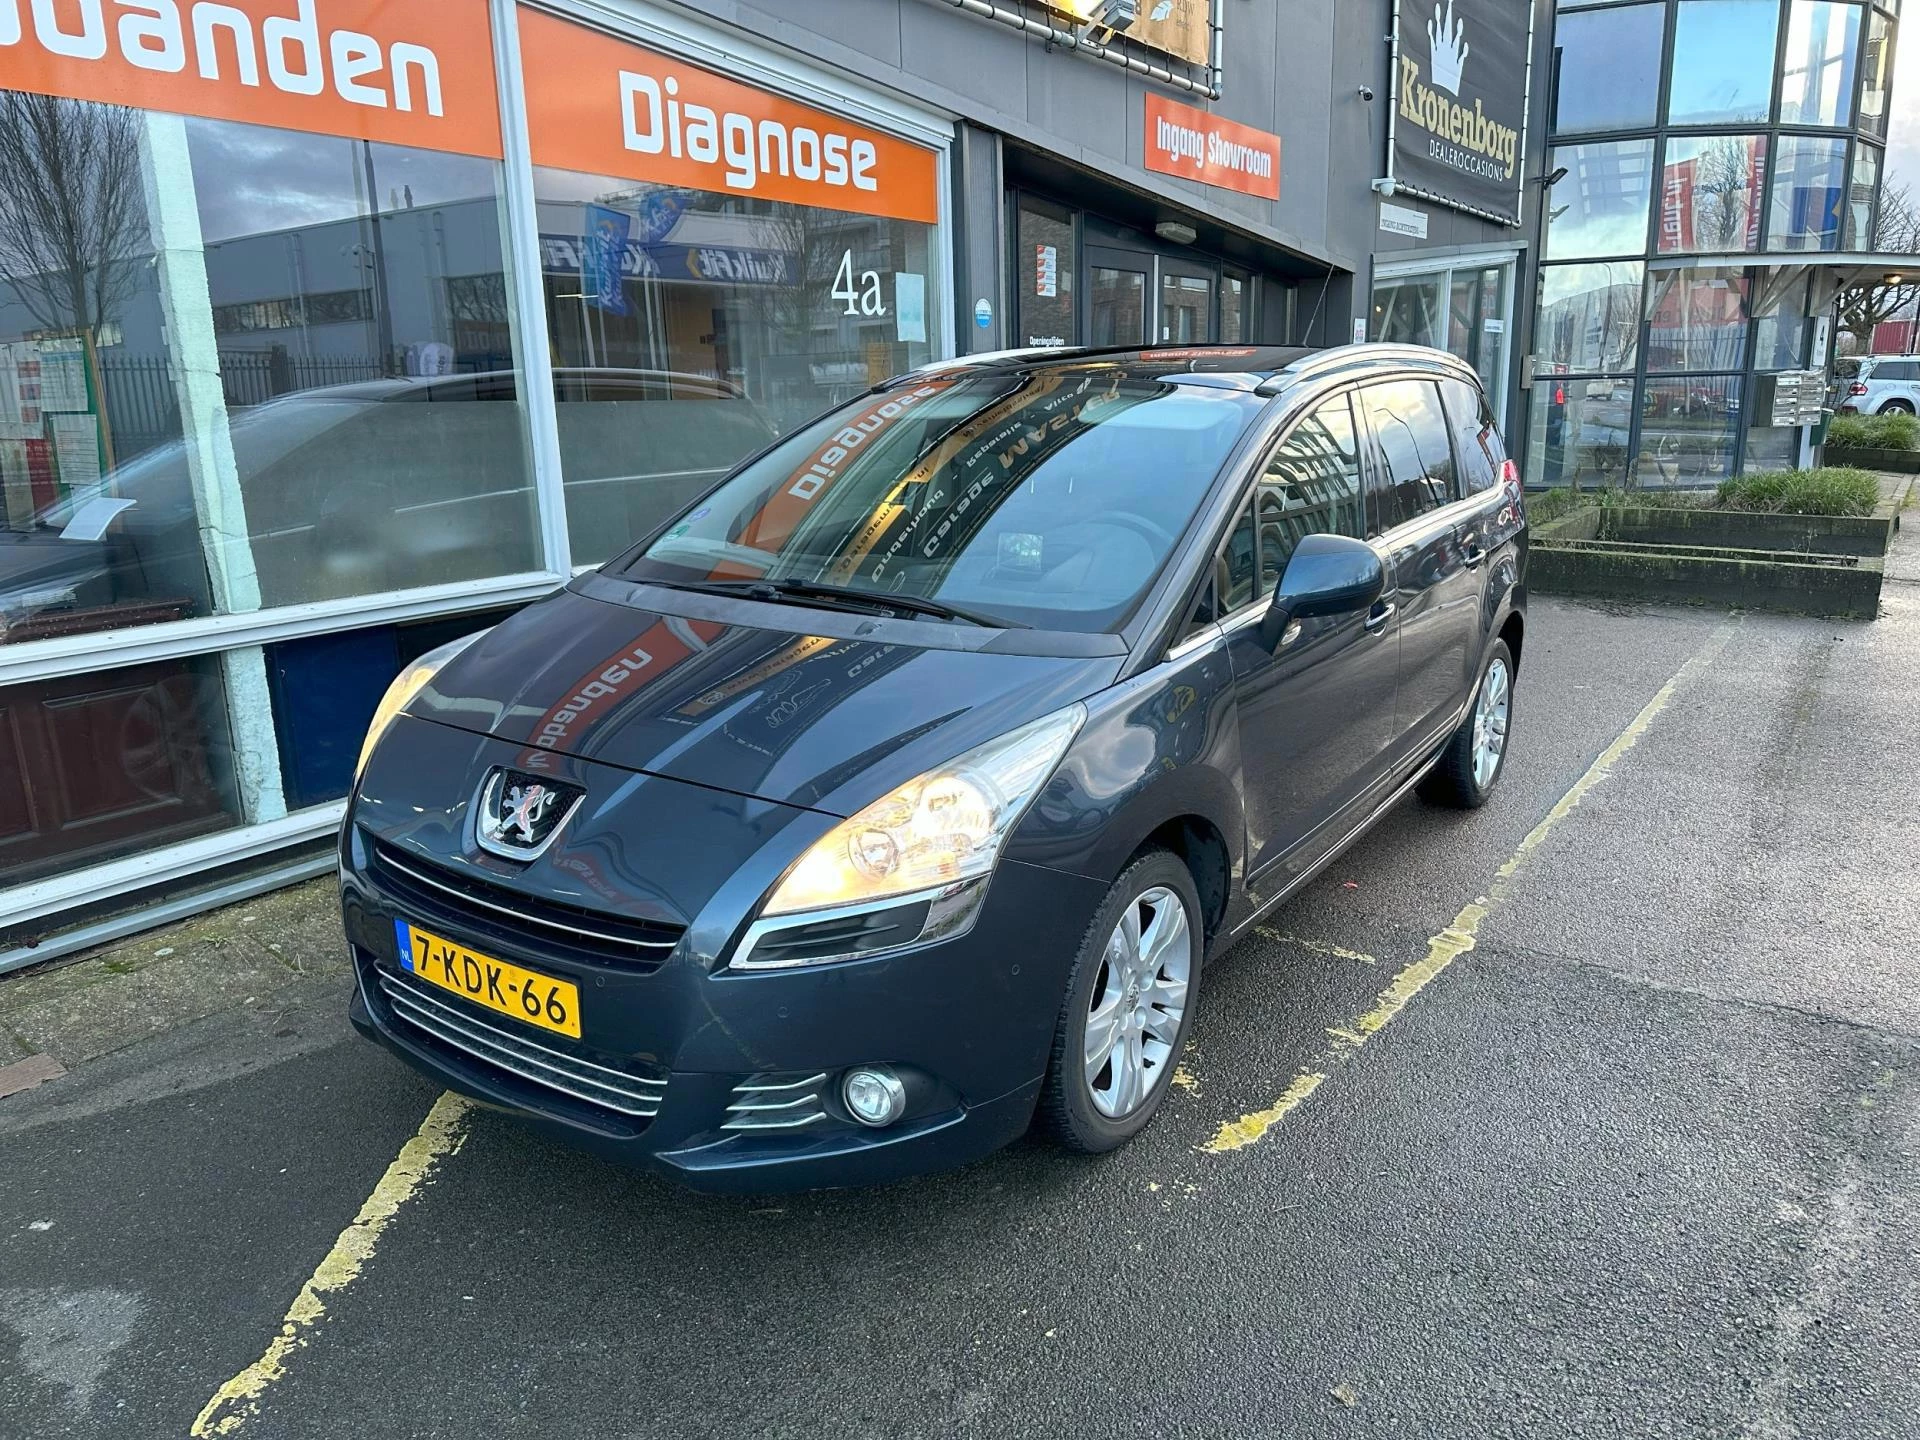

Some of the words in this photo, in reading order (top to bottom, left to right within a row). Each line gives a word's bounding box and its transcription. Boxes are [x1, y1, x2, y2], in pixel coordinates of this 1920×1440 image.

[619, 70, 877, 192] Diagnose
[1156, 114, 1204, 169] Ingang
[1208, 131, 1272, 180] Showroom
[1399, 54, 1517, 179] Kronenborg
[1429, 138, 1504, 182] DEALEROCCASIONS
[831, 249, 886, 317] 4a
[401, 949, 412, 963] NL
[415, 935, 567, 1025] 7-KDK-66
